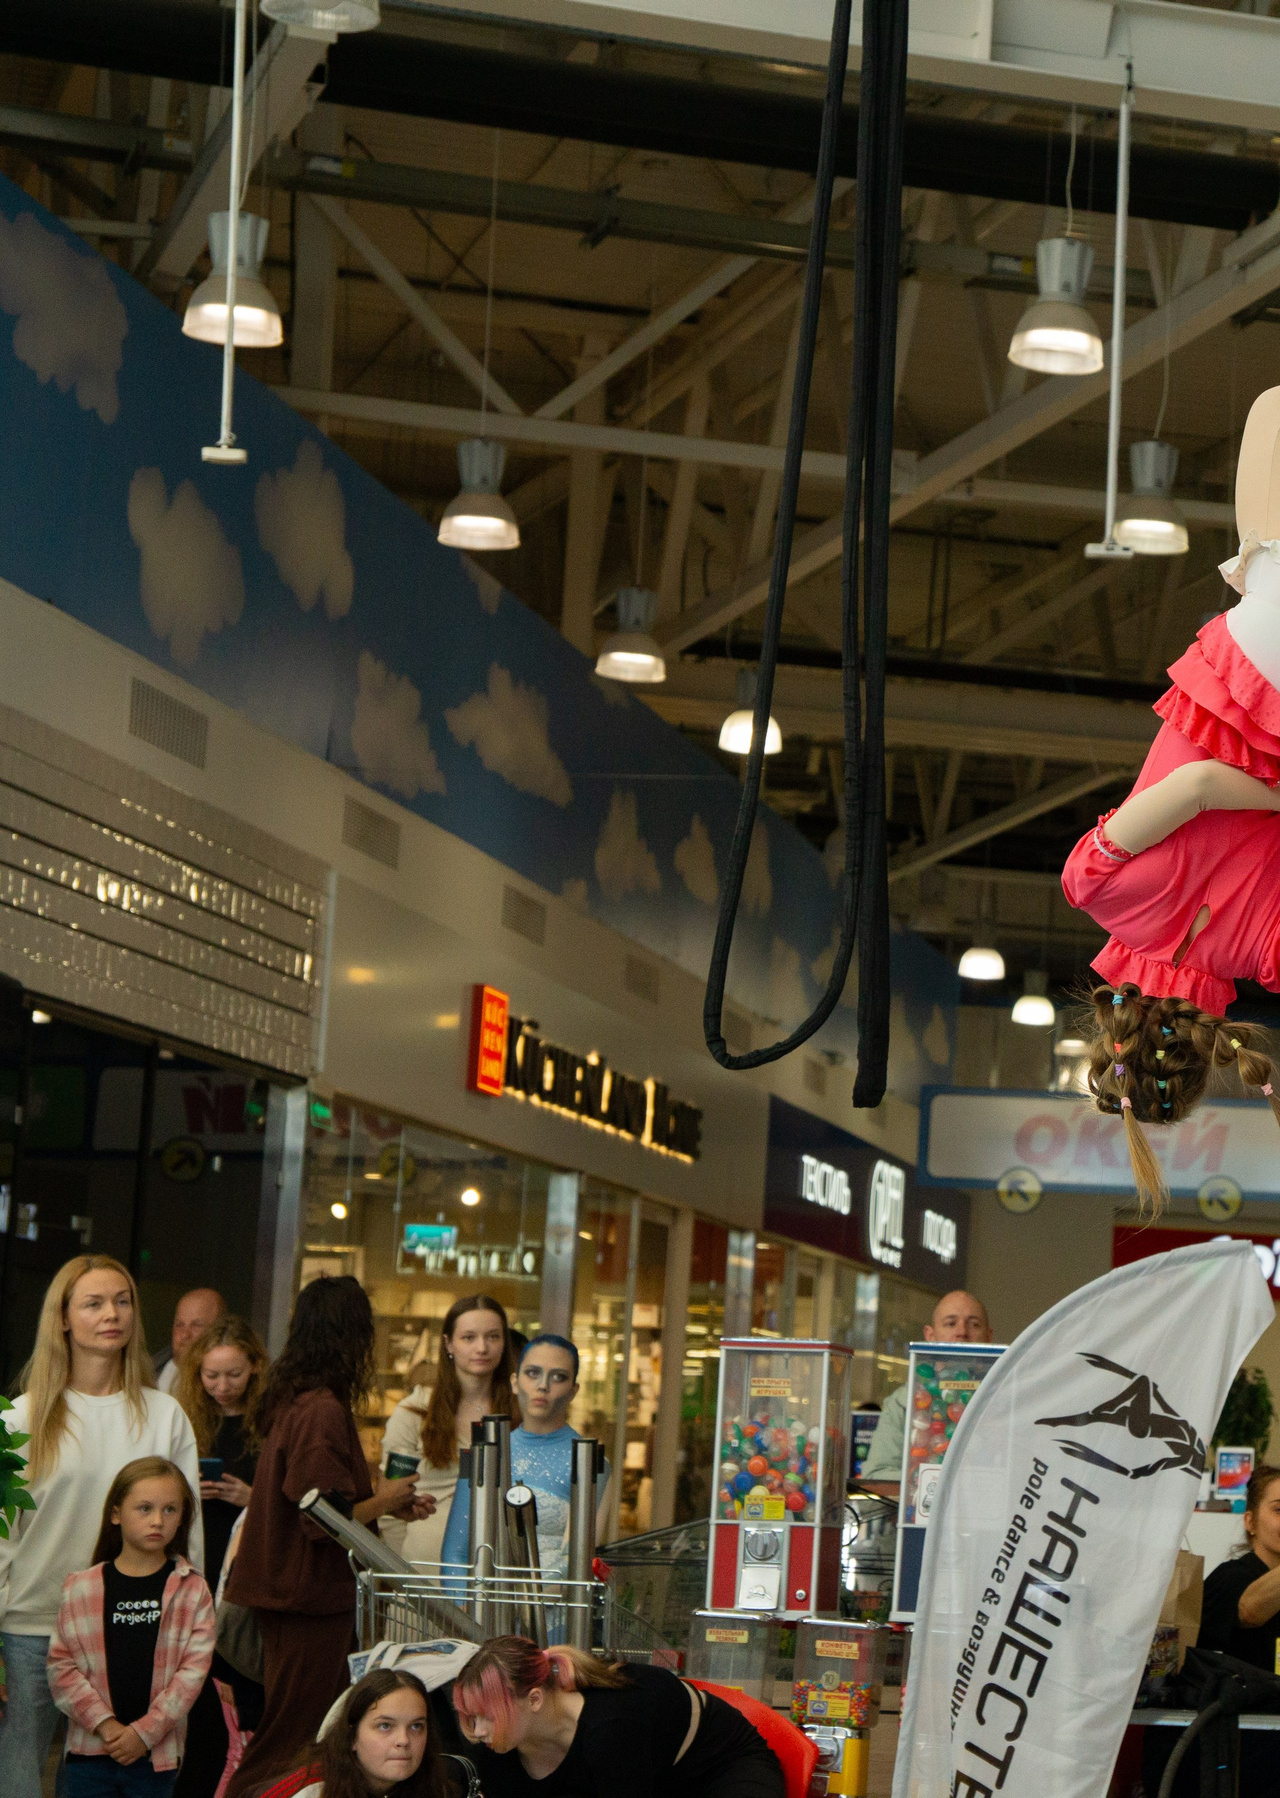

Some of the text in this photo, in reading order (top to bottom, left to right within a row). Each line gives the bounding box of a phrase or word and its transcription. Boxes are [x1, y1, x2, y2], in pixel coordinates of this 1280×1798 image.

[820, 1641, 853, 1650] КОНФЕТЫ
[949, 1457, 1049, 1732] pole dance & воздушн
